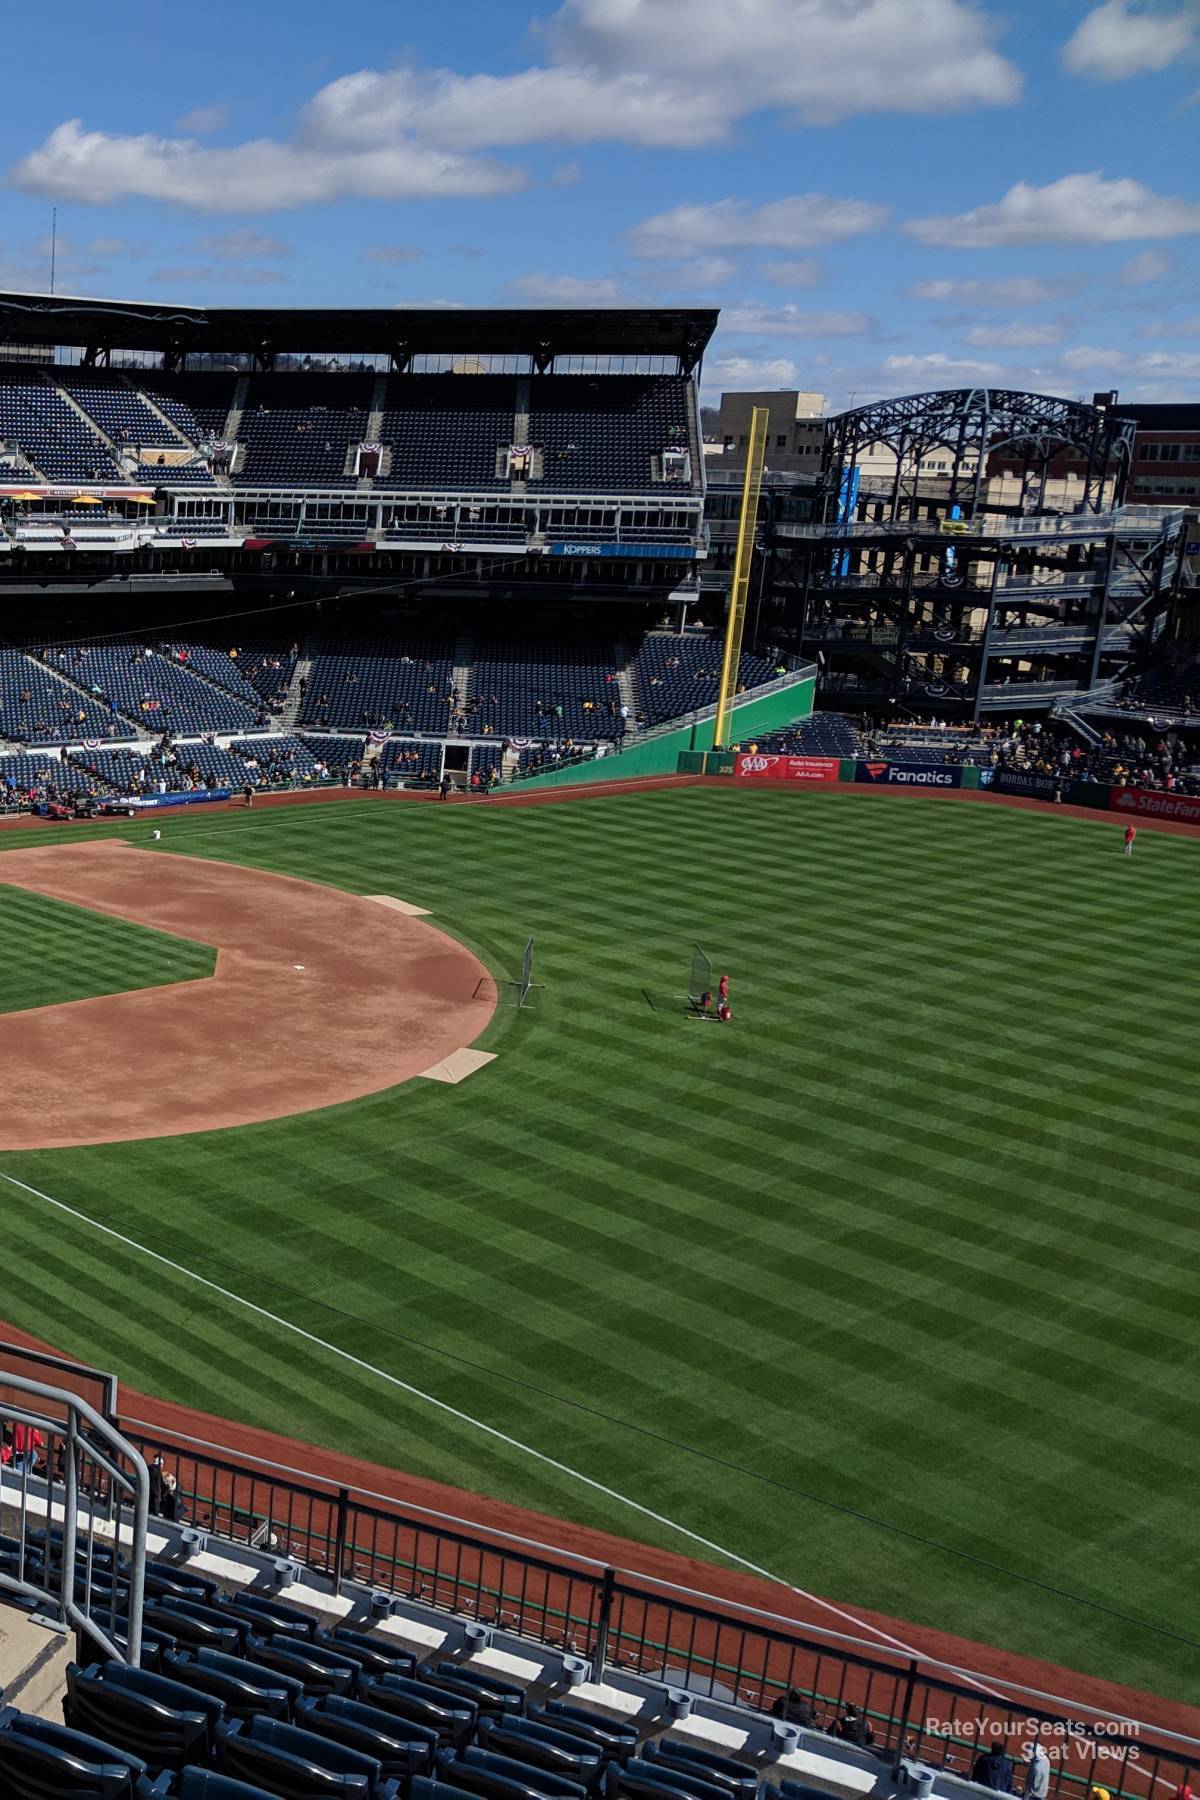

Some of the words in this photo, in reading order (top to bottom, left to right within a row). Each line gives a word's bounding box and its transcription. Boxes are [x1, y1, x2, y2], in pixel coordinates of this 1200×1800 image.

[563, 544, 602, 555] KOPPERS
[795, 770, 825, 778] AAA.com
[888, 767, 953, 784] Fanatics
[1000, 772, 1032, 787] BORDAS
